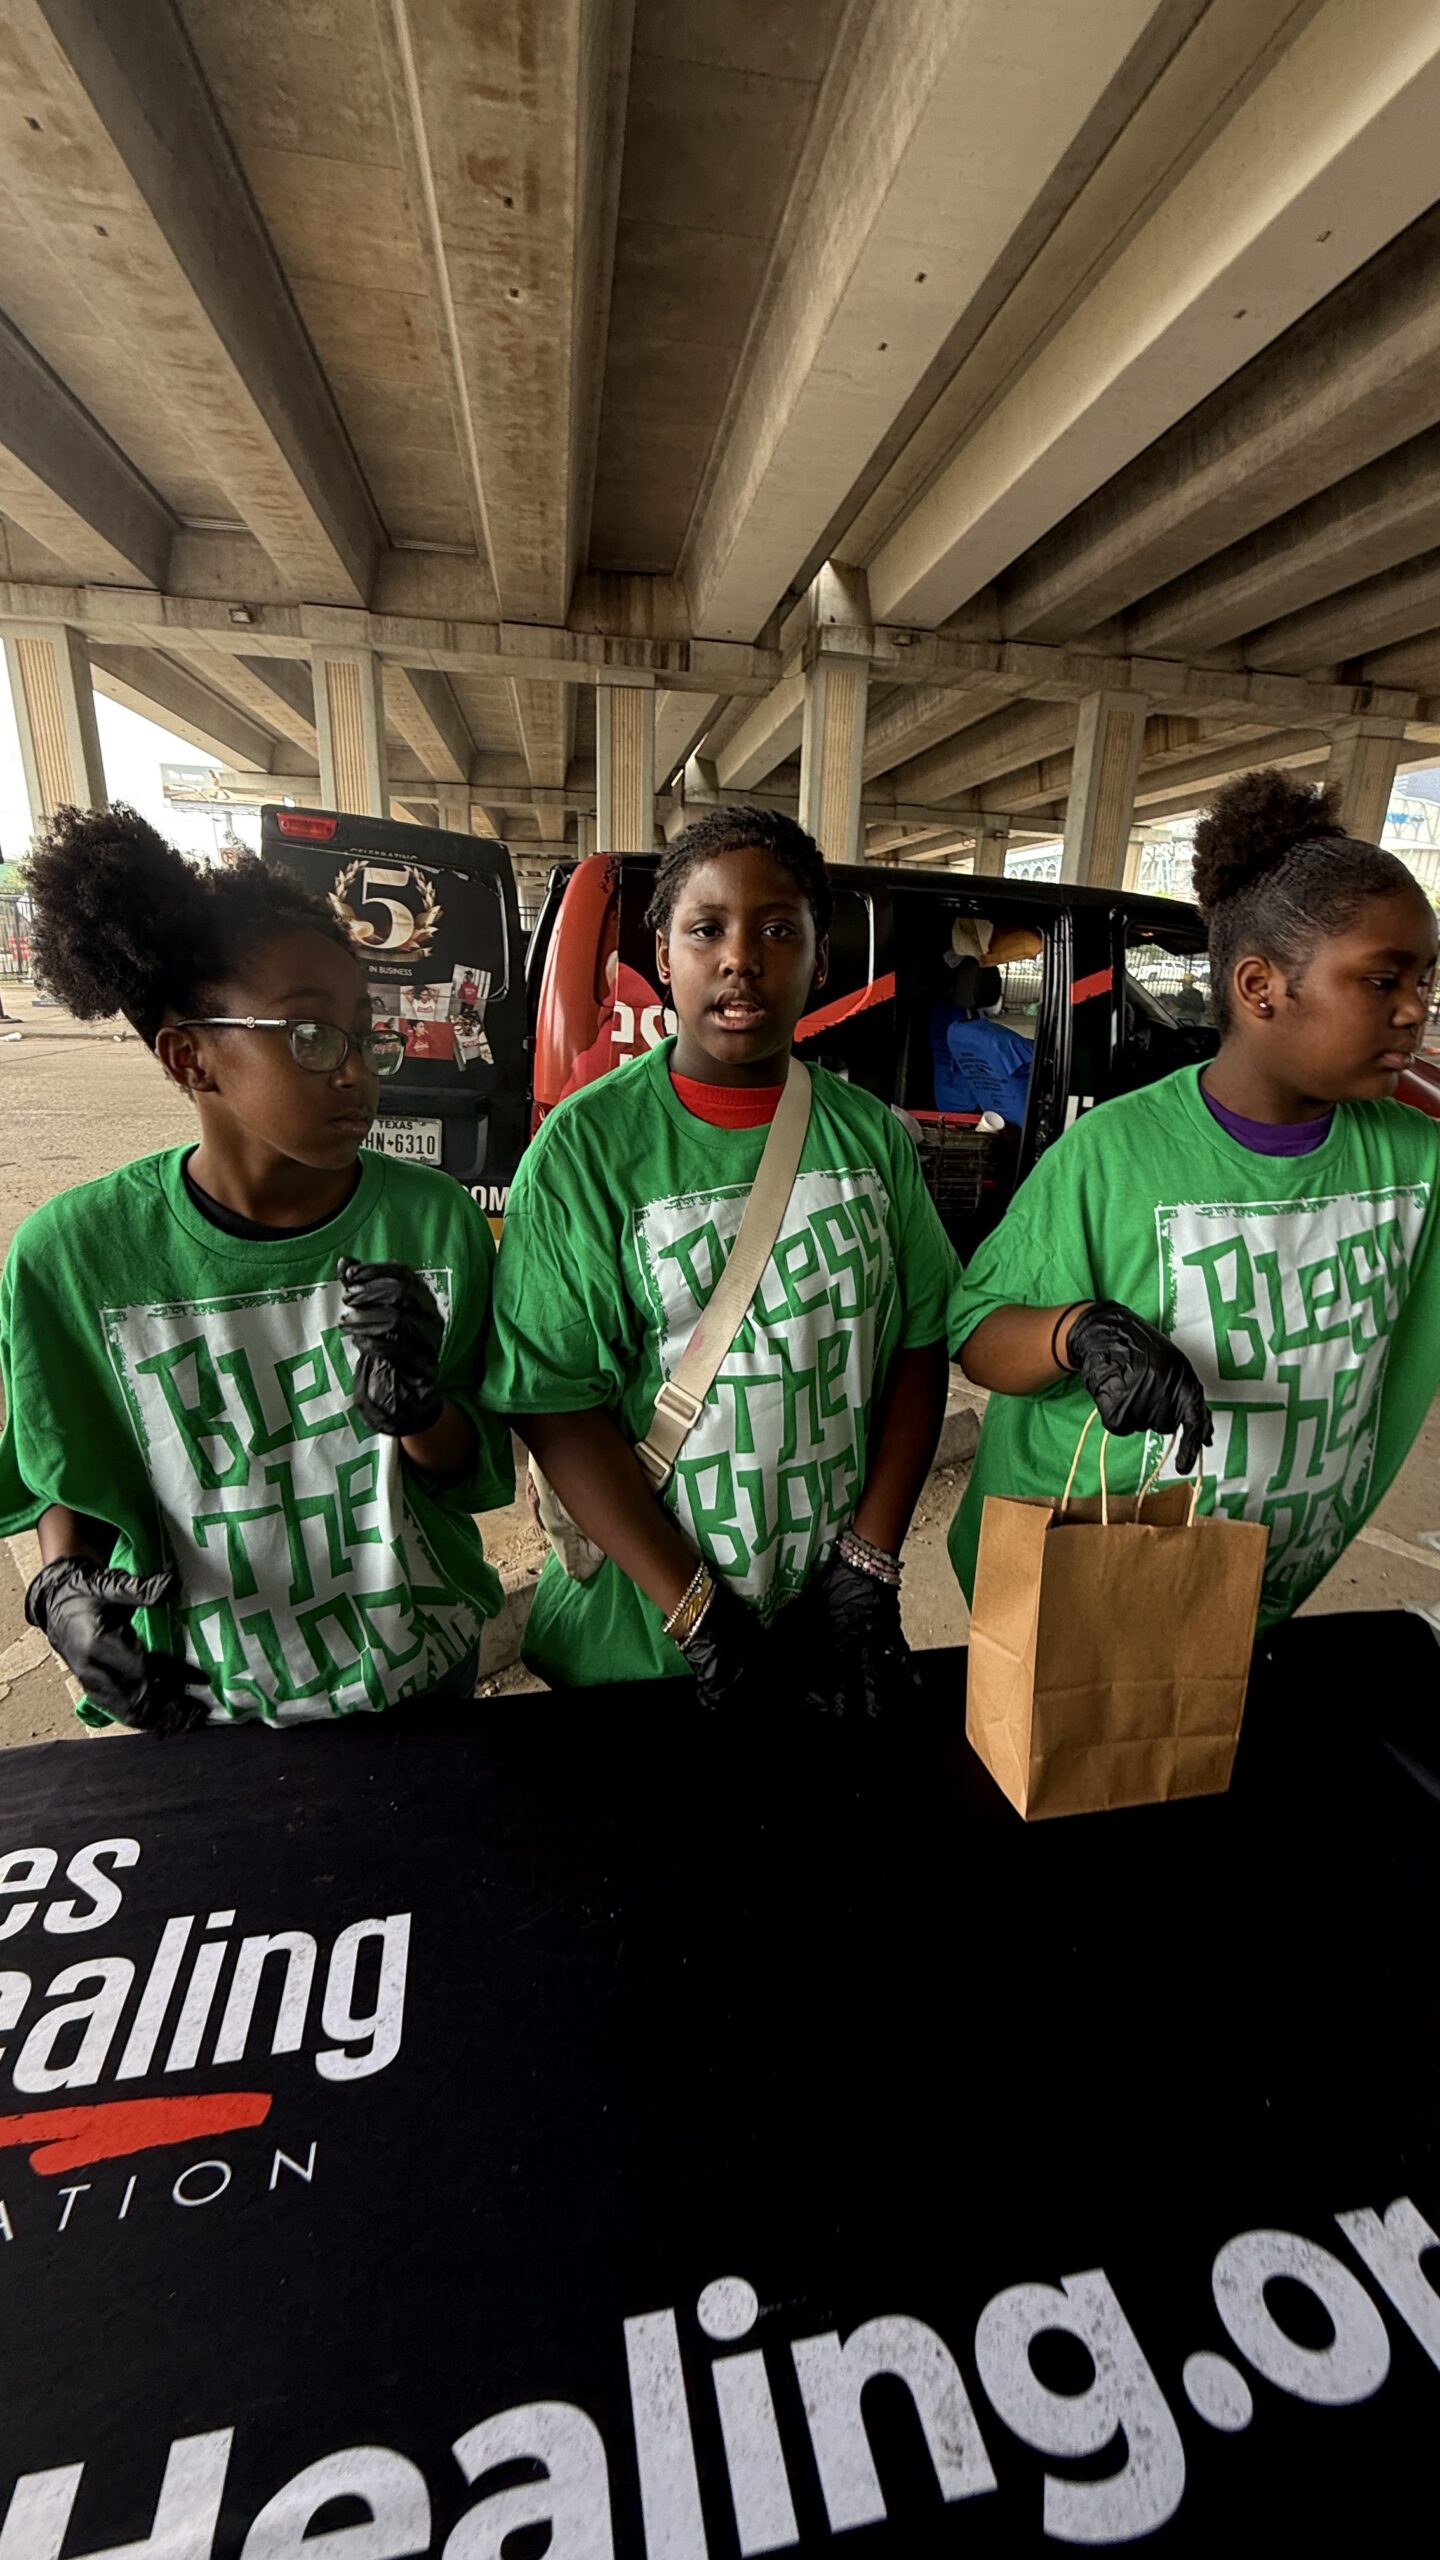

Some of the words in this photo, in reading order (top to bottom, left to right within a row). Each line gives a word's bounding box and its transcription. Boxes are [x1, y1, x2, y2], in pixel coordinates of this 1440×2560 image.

[350, 867, 414, 949] 5
[368, 965, 377, 973] IN
[378, 966, 413, 977] BUSINESS
[378, 1120, 413, 1130] TEXAS
[192, 1450, 383, 1606] The
